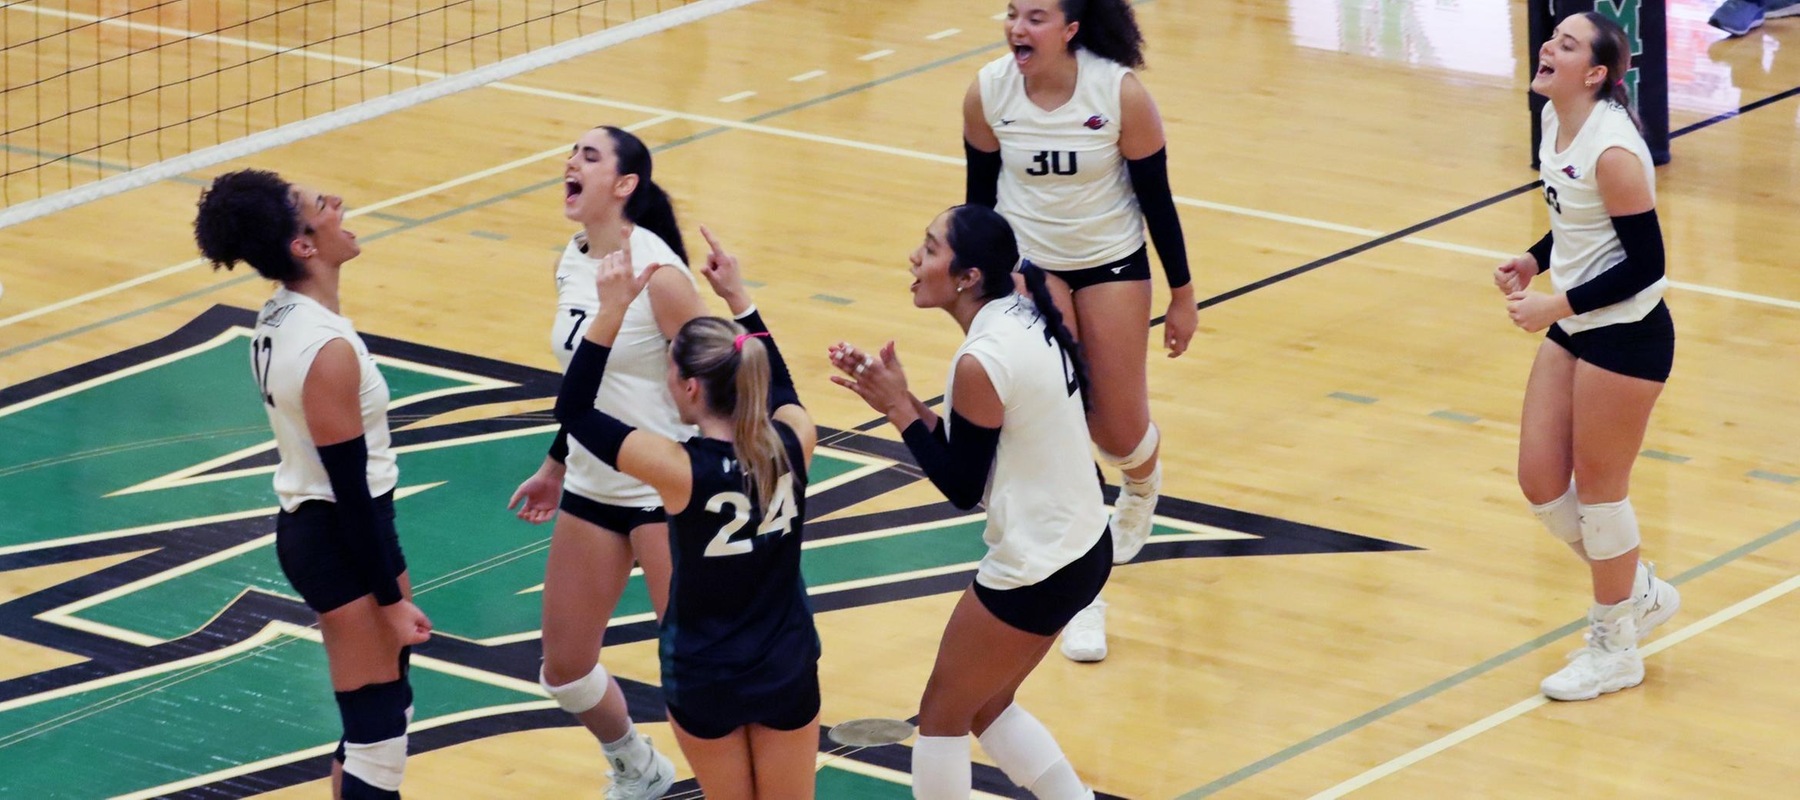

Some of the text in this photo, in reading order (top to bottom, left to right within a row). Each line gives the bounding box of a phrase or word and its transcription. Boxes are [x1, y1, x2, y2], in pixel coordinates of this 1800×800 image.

[1026, 151, 1078, 176] 30
[564, 308, 587, 351] 7
[253, 335, 276, 408] 12
[703, 472, 799, 557] 24
